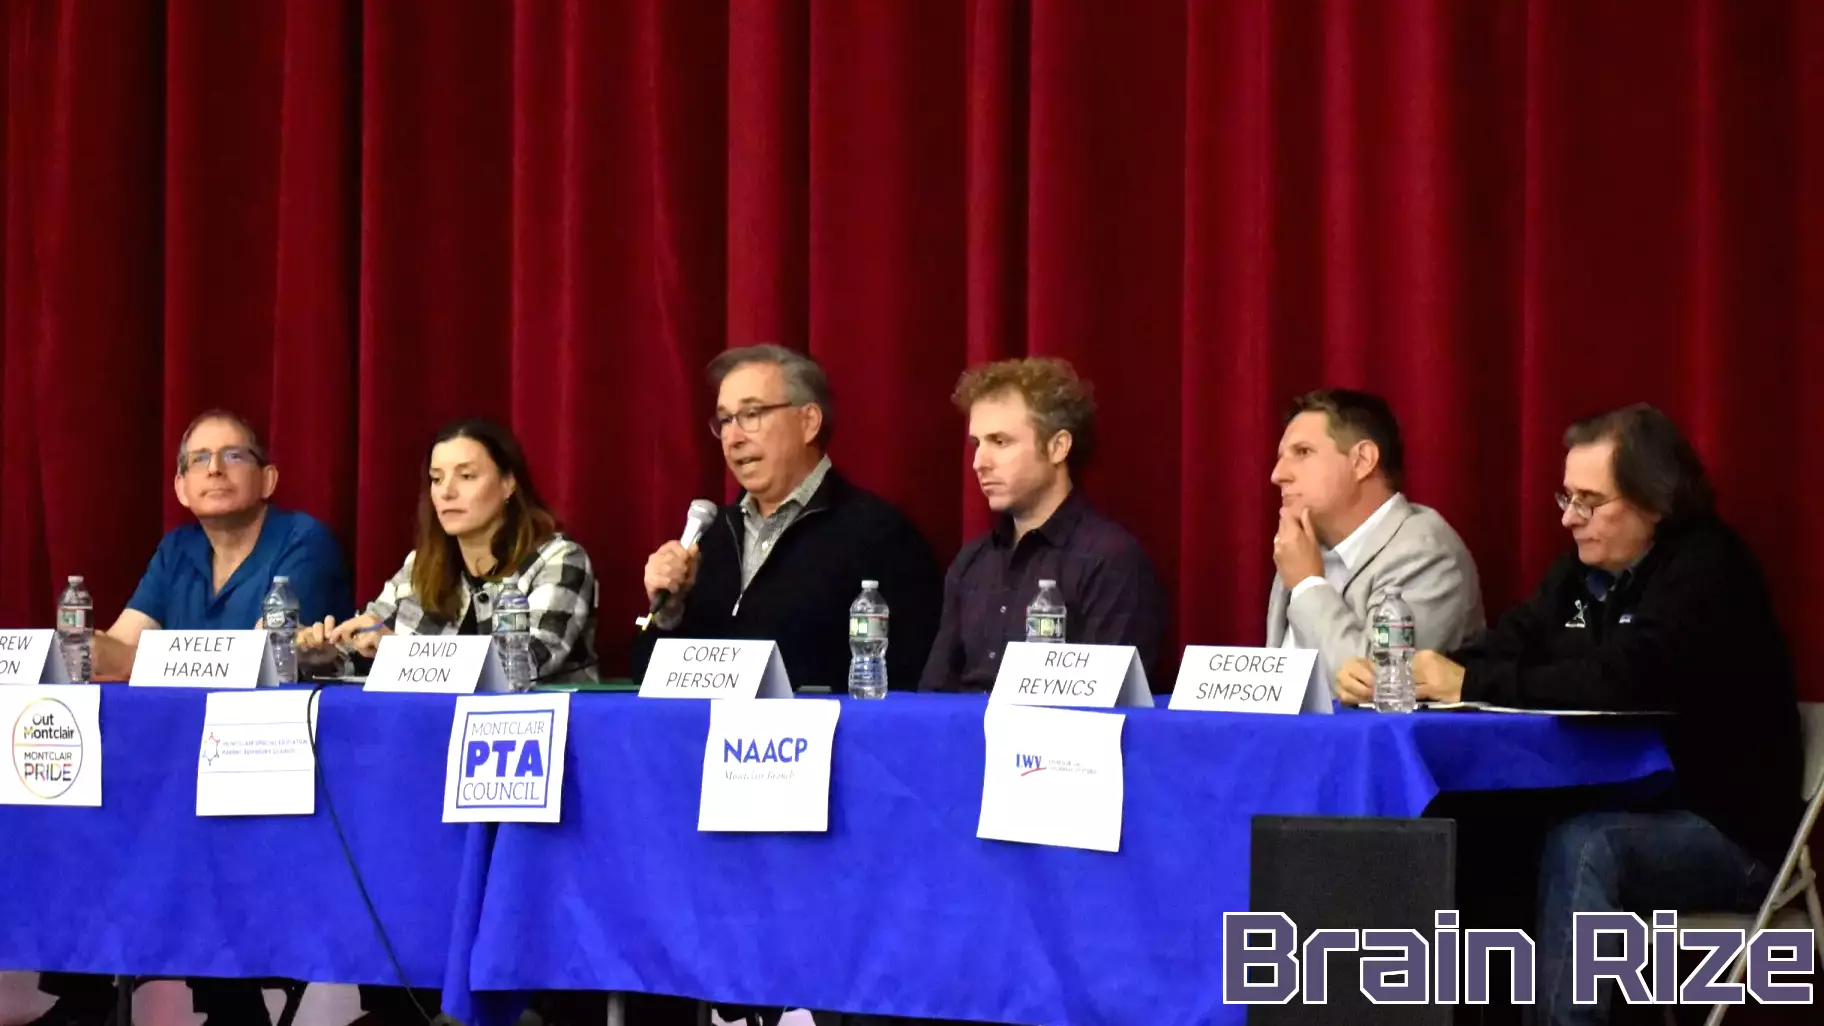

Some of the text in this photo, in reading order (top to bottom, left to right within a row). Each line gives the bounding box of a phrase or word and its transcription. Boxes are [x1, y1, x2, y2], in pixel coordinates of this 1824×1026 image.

[0, 636, 33, 650] REW
[169, 637, 235, 651] AYELET
[409, 642, 457, 657] DAVID
[683, 646, 741, 662] COREY
[1045, 651, 1089, 667] RICH
[164, 662, 229, 677] HARAN
[1209, 654, 1287, 673] GEORGE
[398, 668, 450, 682] MOON
[666, 672, 739, 688] PIERSON
[1019, 678, 1096, 696] REYNICS
[1196, 683, 1282, 701] SIMPSON
[32, 713, 54, 726] Out
[24, 726, 74, 739] Montclair
[471, 720, 545, 736] MONTCLAIR
[24, 751, 72, 761] MONTCLAIR
[723, 737, 808, 763] NAACP
[465, 739, 543, 778] PTA
[24, 763, 72, 781] PRIDE
[462, 782, 539, 801] COUNCIL
